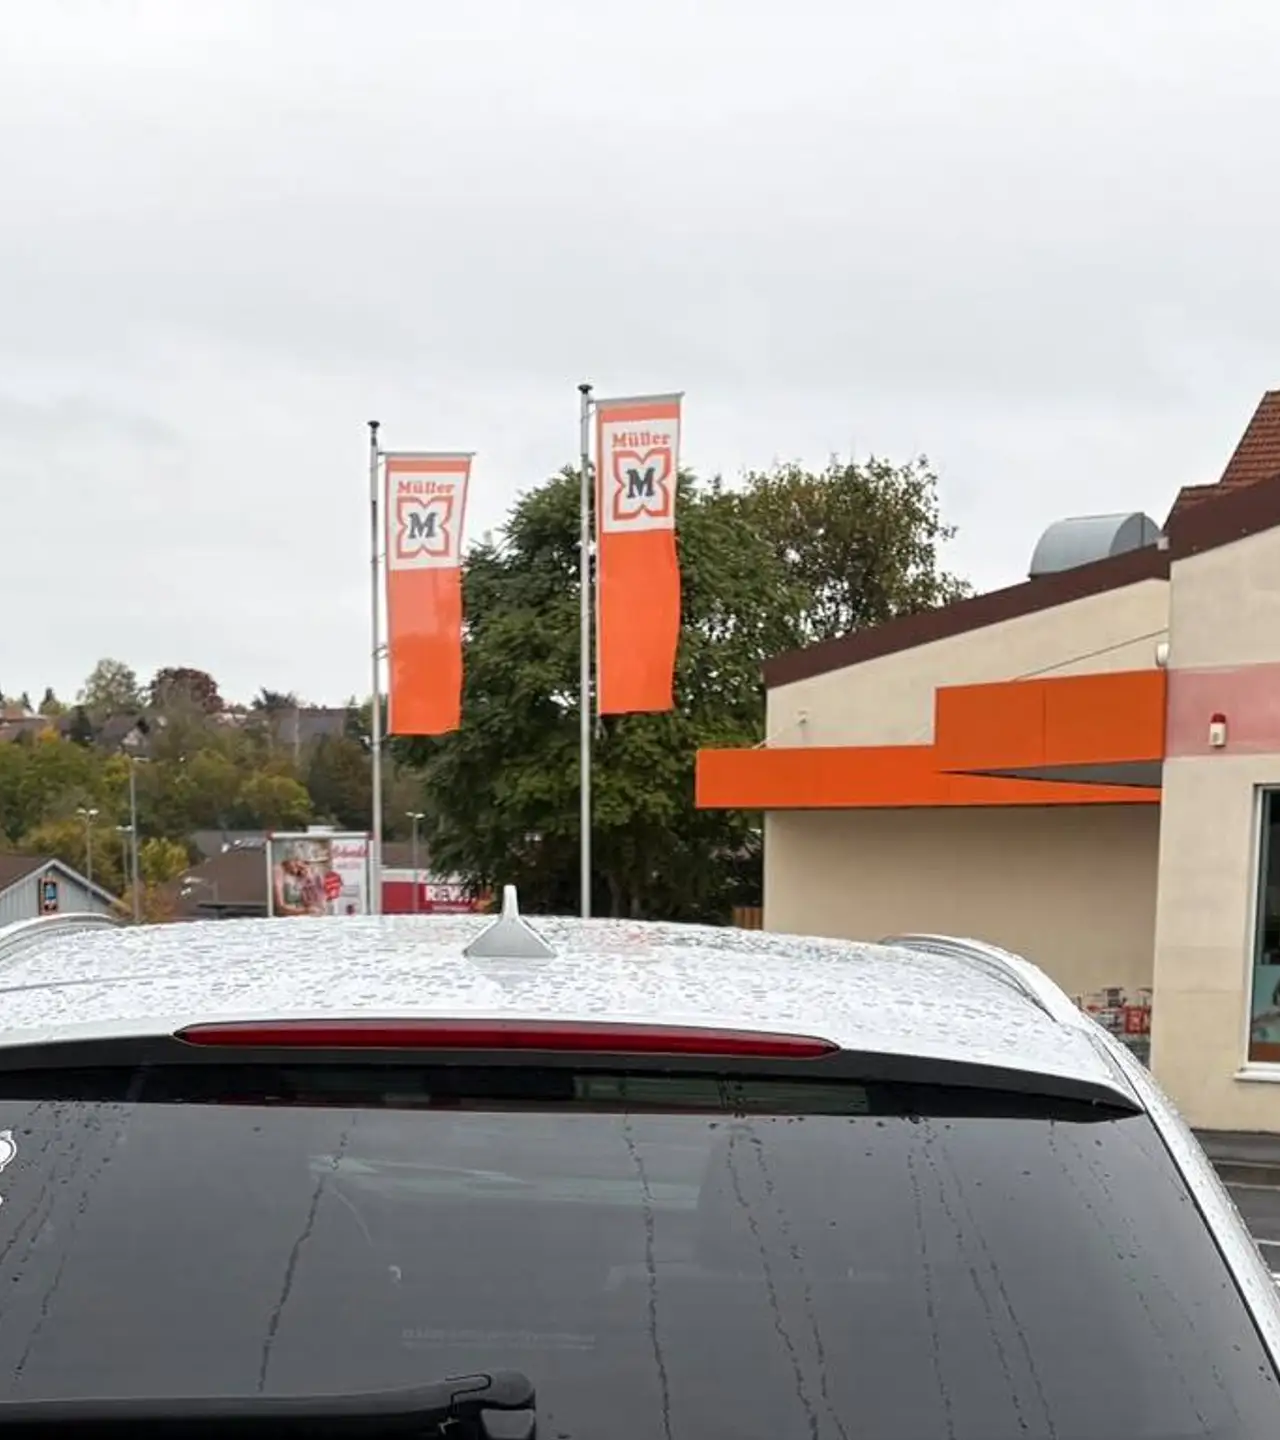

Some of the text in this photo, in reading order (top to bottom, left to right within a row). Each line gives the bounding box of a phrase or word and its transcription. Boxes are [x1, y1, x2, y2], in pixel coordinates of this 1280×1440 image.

[612, 430, 671, 447] Müller
[397, 480, 455, 494] Müller
[626, 467, 656, 498] M
[407, 512, 438, 539] M
